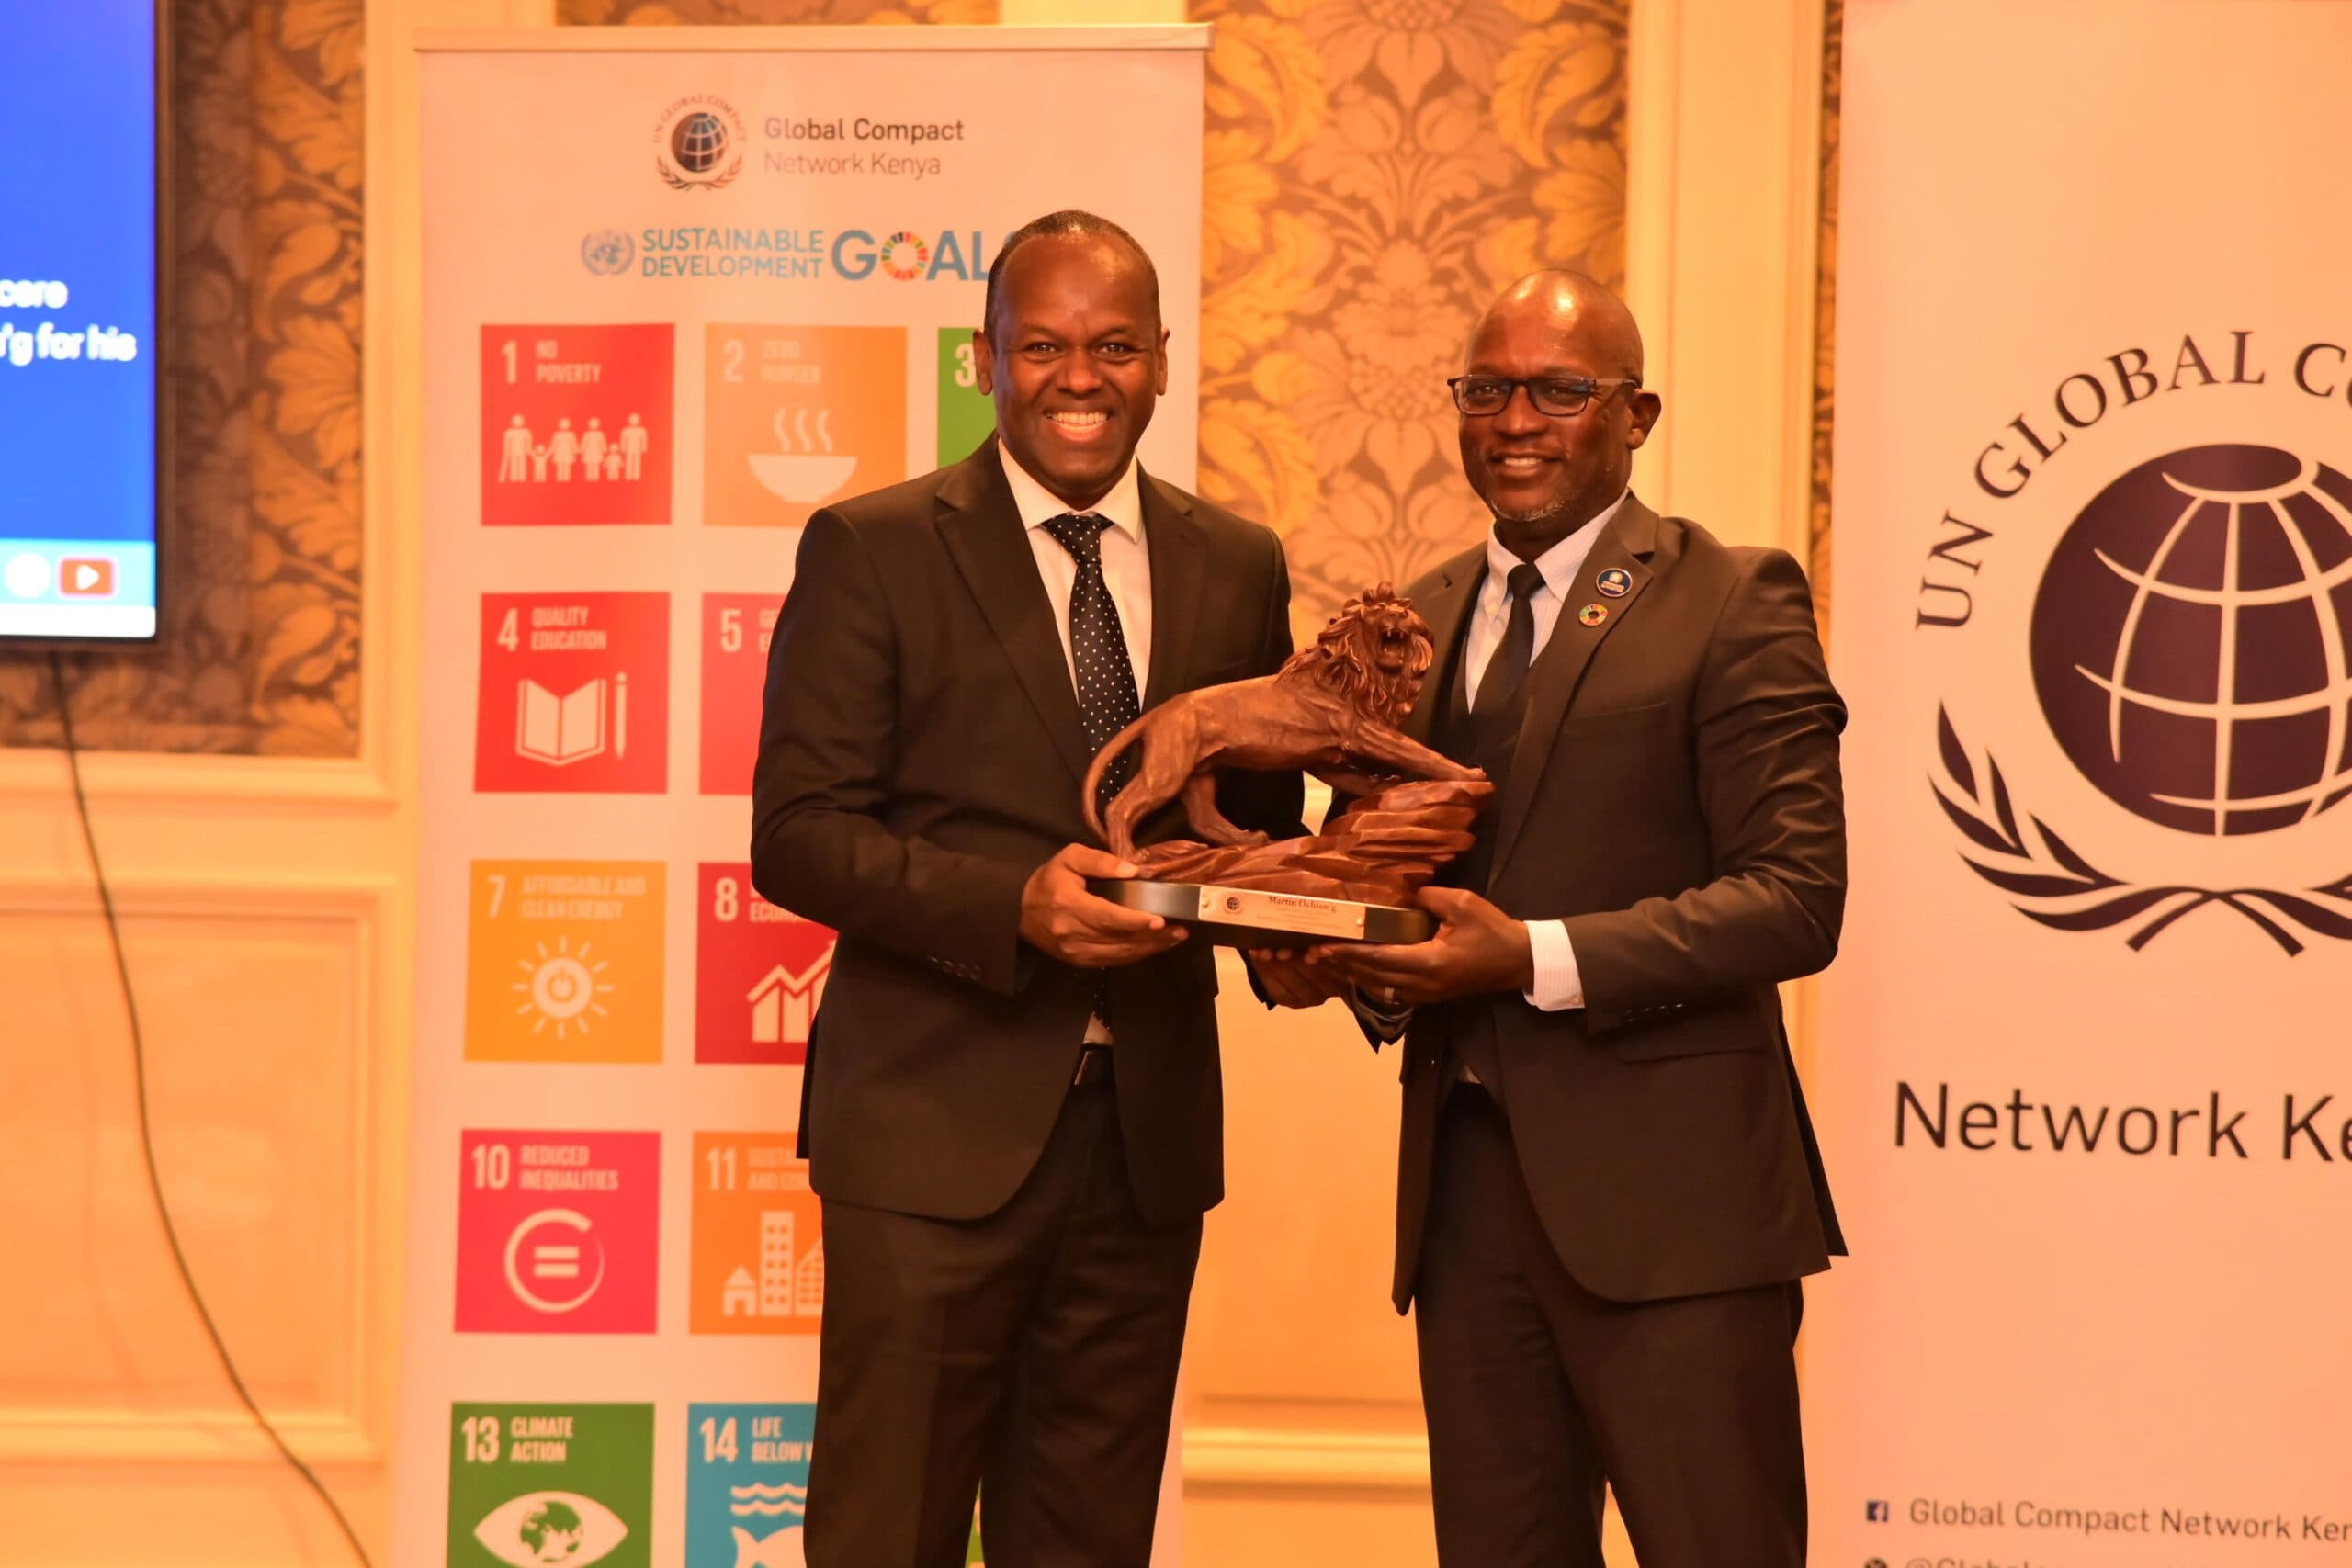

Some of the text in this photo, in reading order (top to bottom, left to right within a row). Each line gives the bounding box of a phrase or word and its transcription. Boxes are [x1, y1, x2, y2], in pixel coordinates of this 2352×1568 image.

[764, 118, 965, 145] Global Compact
[763, 151, 942, 181] Network Kenya
[642, 228, 824, 252] SUSTAINABLE
[831, 230, 1017, 281] GOAL
[642, 255, 824, 279] DEVELOPMENT
[37, 321, 85, 359] for
[86, 323, 137, 361] his
[501, 340, 517, 384] 1
[723, 339, 745, 383] 2
[956, 343, 977, 387] 3
[1915, 508, 1993, 631] UN
[1973, 330, 2267, 499] GLOBAL
[497, 606, 519, 651] 4
[531, 630, 607, 650] EDUCATION
[721, 608, 742, 653] 5
[487, 874, 506, 919] 7
[716, 877, 738, 921] 8
[1894, 1080, 2250, 1160] Network
[471, 1144, 510, 1190] 10
[520, 1145, 590, 1166] REDUCED
[706, 1146, 736, 1191] 11
[520, 1168, 620, 1191] INEQUALITIES
[462, 1416, 500, 1462] 13
[511, 1416, 573, 1438] CLIMATE
[701, 1416, 739, 1462] 14
[752, 1417, 783, 1438] LIFE
[510, 1441, 567, 1462] ACTION
[752, 1441, 804, 1462] BELOW
[1909, 1498, 2006, 1527] Global
[2015, 1500, 2151, 1536] Compact
[2160, 1507, 2292, 1540] Network
